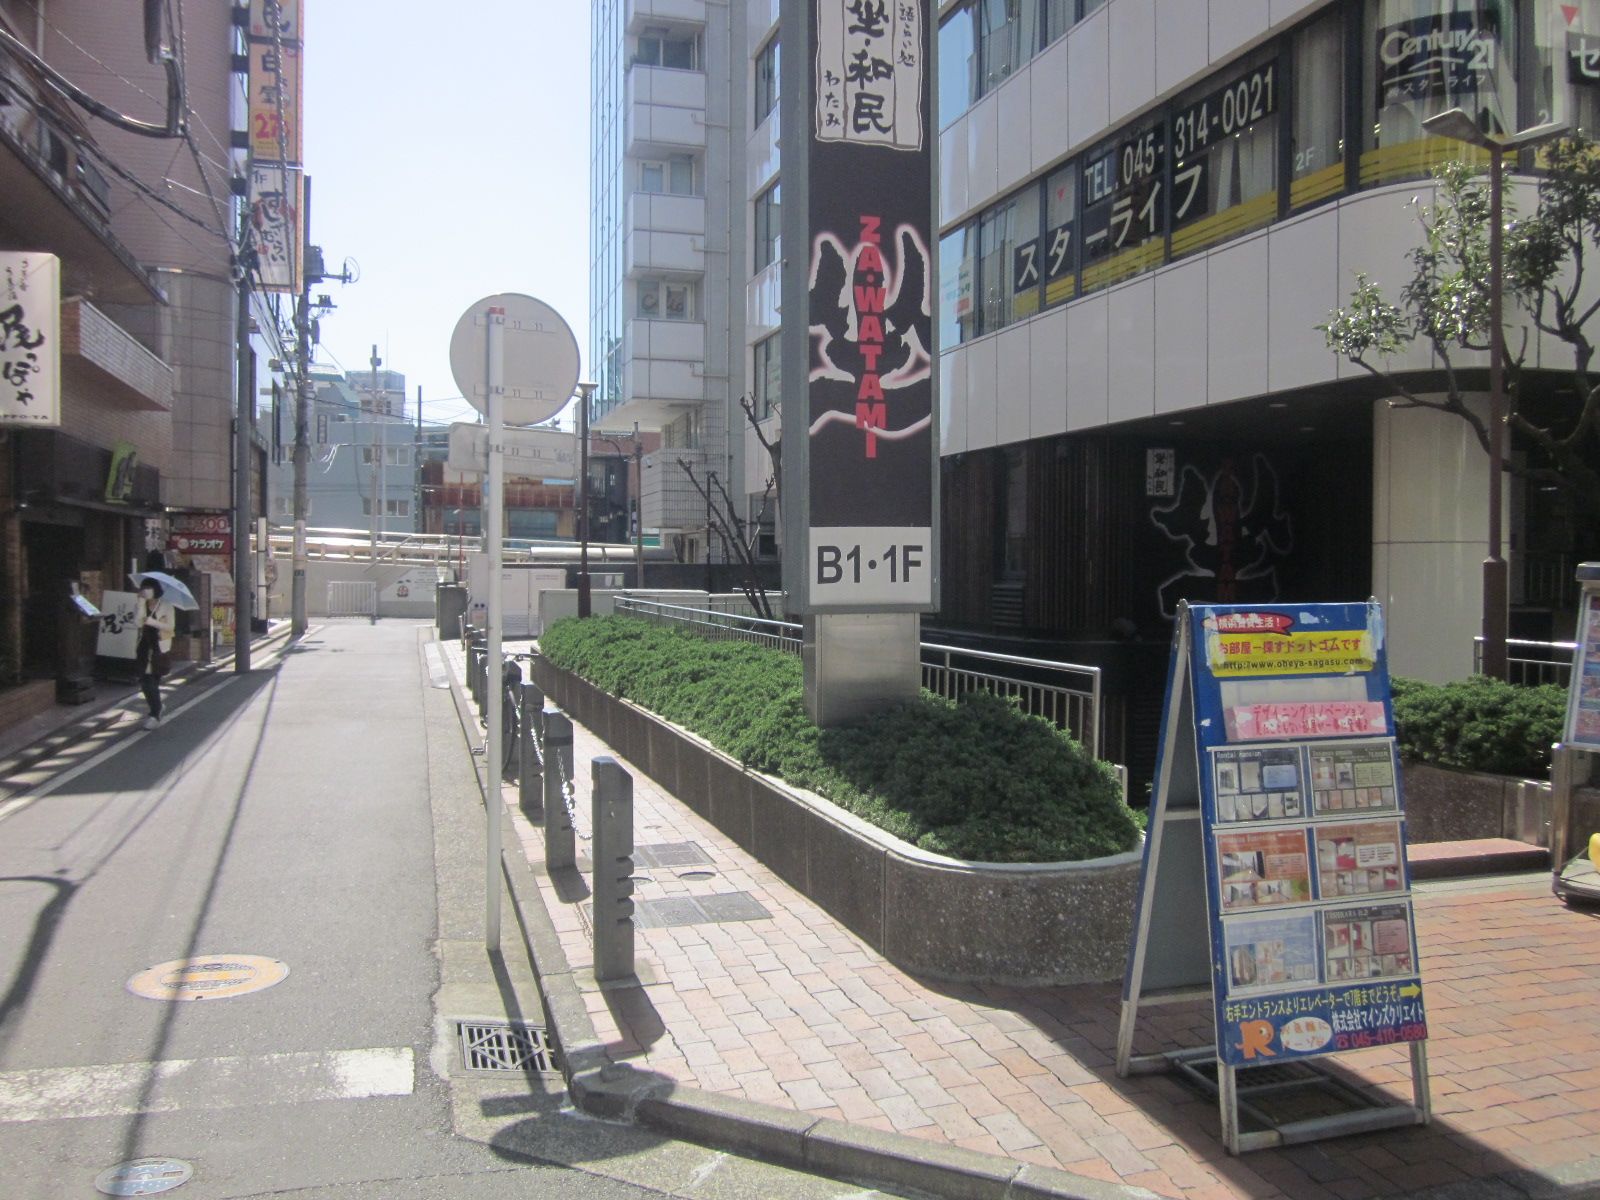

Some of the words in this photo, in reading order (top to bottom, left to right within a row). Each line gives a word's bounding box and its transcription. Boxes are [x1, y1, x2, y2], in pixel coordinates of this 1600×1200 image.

[1380, 28, 1475, 66] Century
[1467, 39, 1495, 70] 21
[824, 70, 841, 128] わたみ
[1295, 147, 1315, 171] 2F
[1017, 163, 1203, 288] スターライフ
